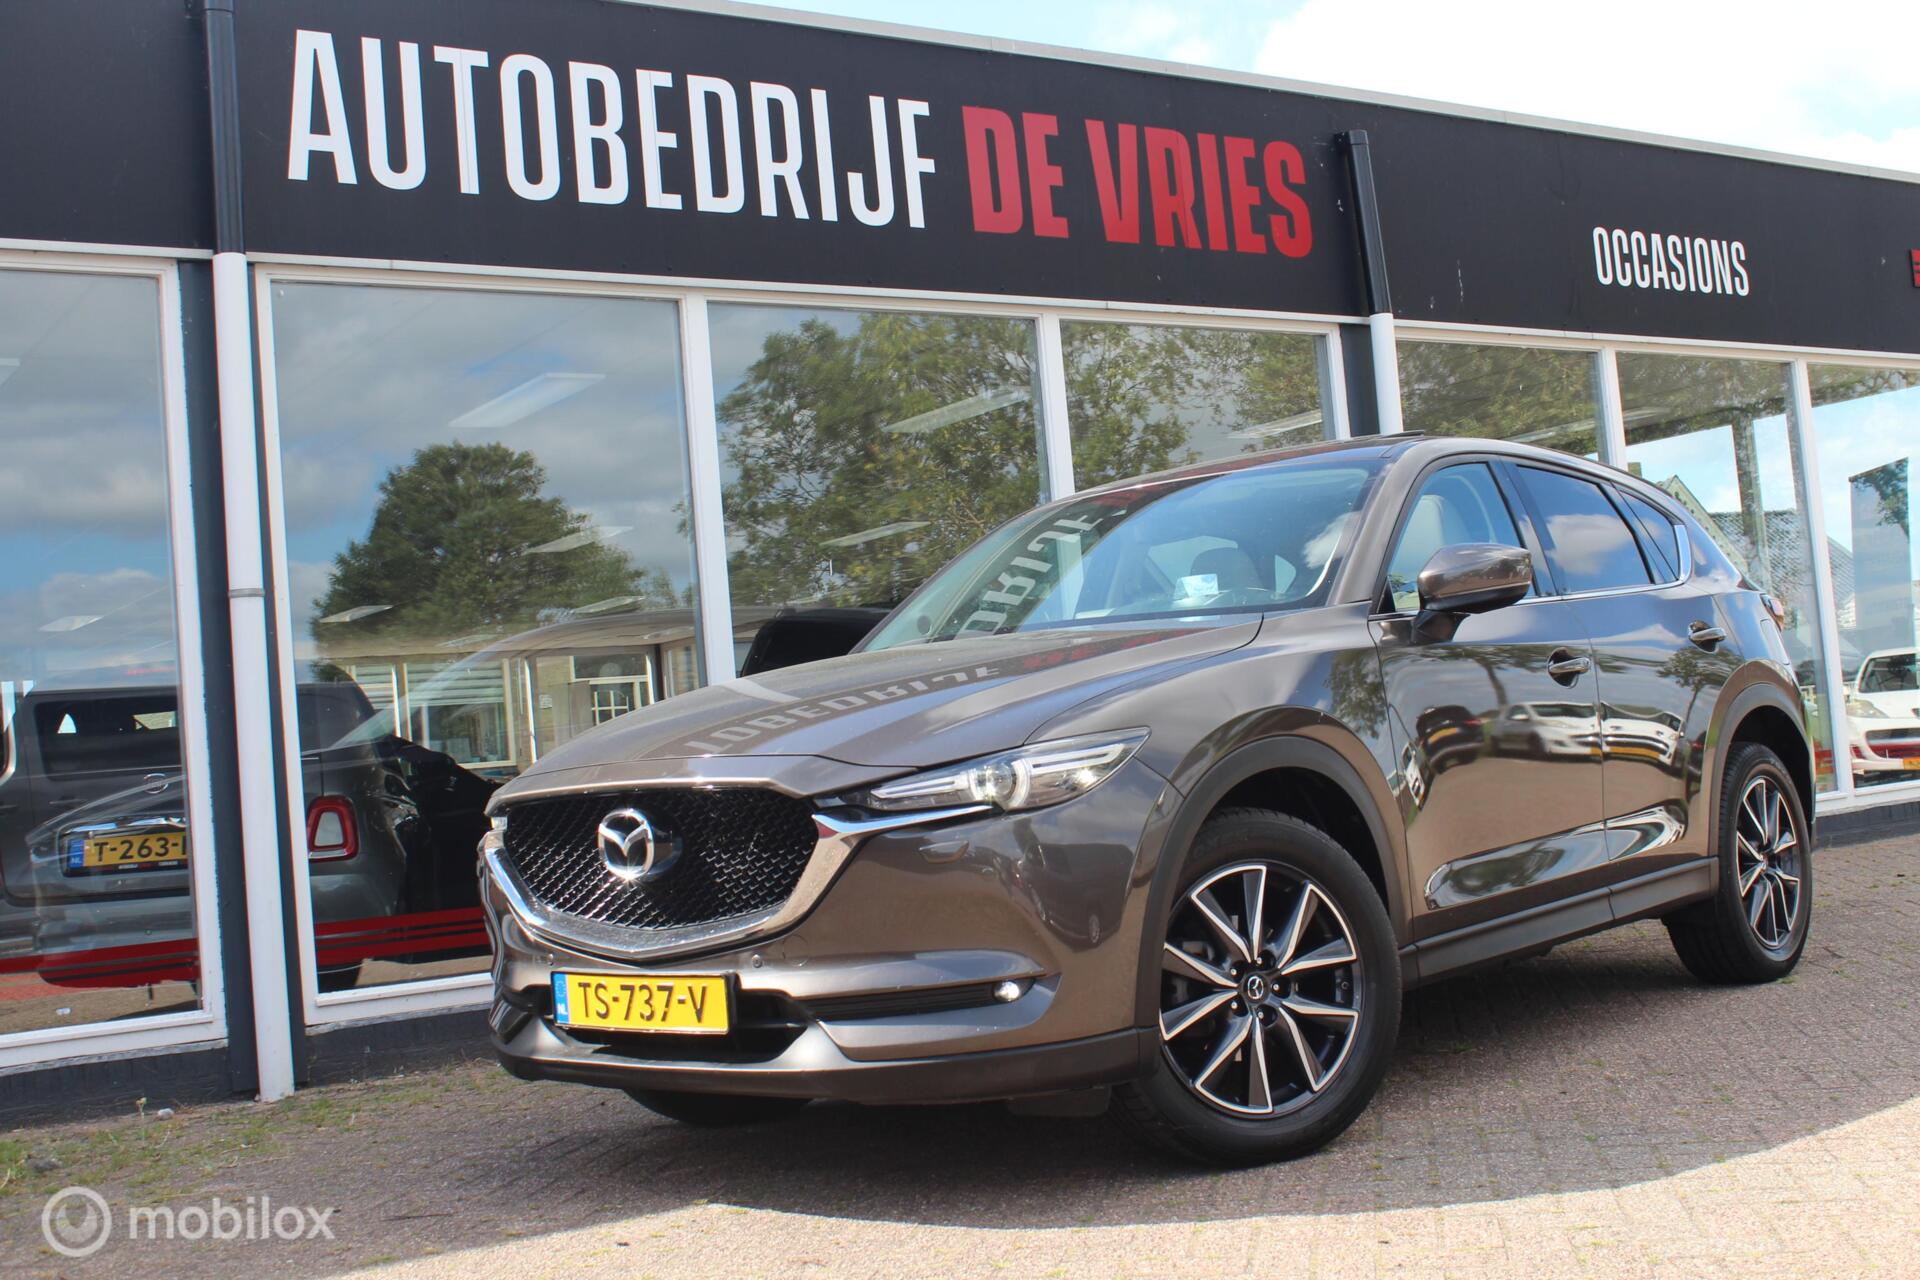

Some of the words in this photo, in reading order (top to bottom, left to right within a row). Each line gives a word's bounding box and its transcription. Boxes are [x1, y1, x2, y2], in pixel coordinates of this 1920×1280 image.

[288, 29, 936, 229] AUTOBEDRIJF
[961, 105, 1069, 239] DE
[1084, 118, 1313, 258] VRIES
[1593, 226, 1749, 297] OCCASIONS
[94, 837, 186, 862] T-263-
[557, 1003, 568, 1015] NL
[577, 982, 707, 1023] TS-737-V
